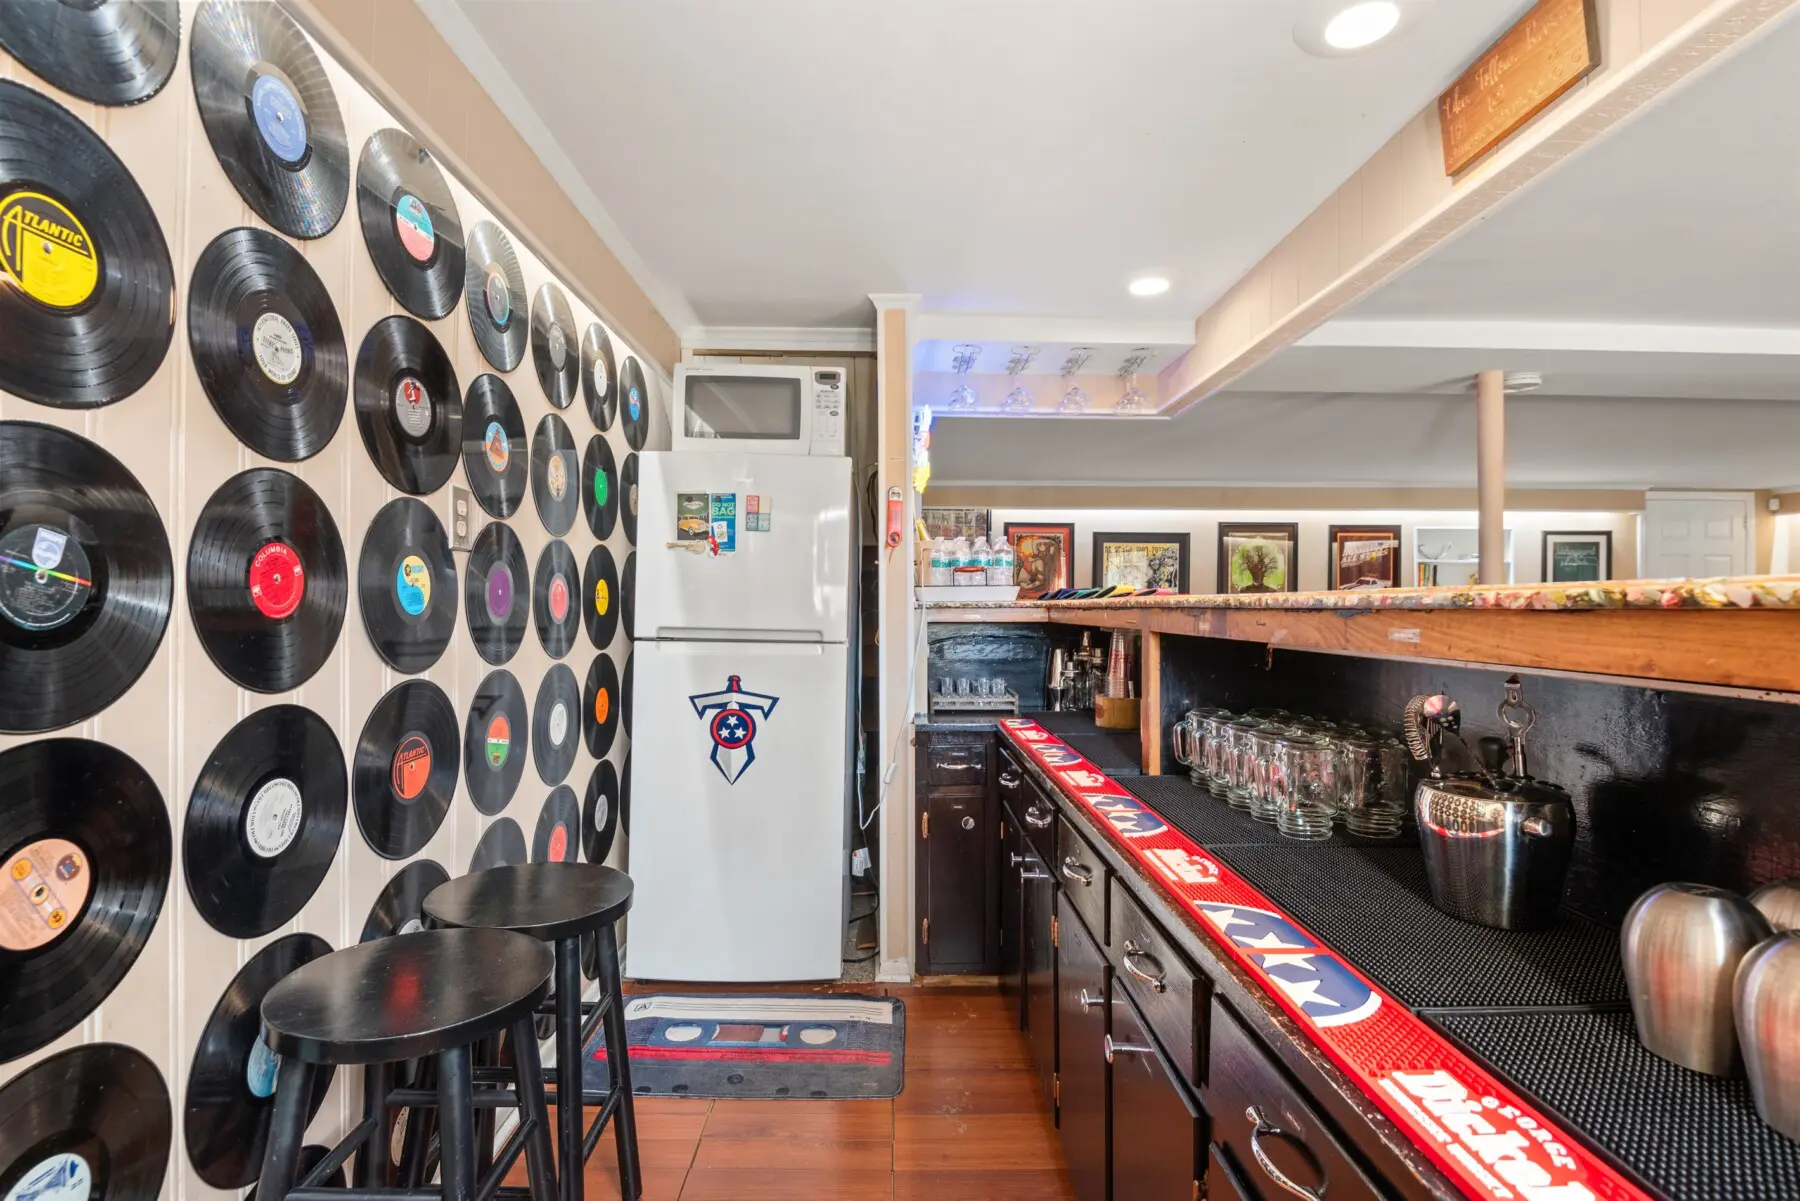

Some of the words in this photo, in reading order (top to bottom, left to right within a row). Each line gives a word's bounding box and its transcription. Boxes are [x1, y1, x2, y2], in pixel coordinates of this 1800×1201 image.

[2, 205, 83, 268] ATLANTIC
[711, 507, 735, 515] BAG
[255, 545, 288, 567] COLUMBIA
